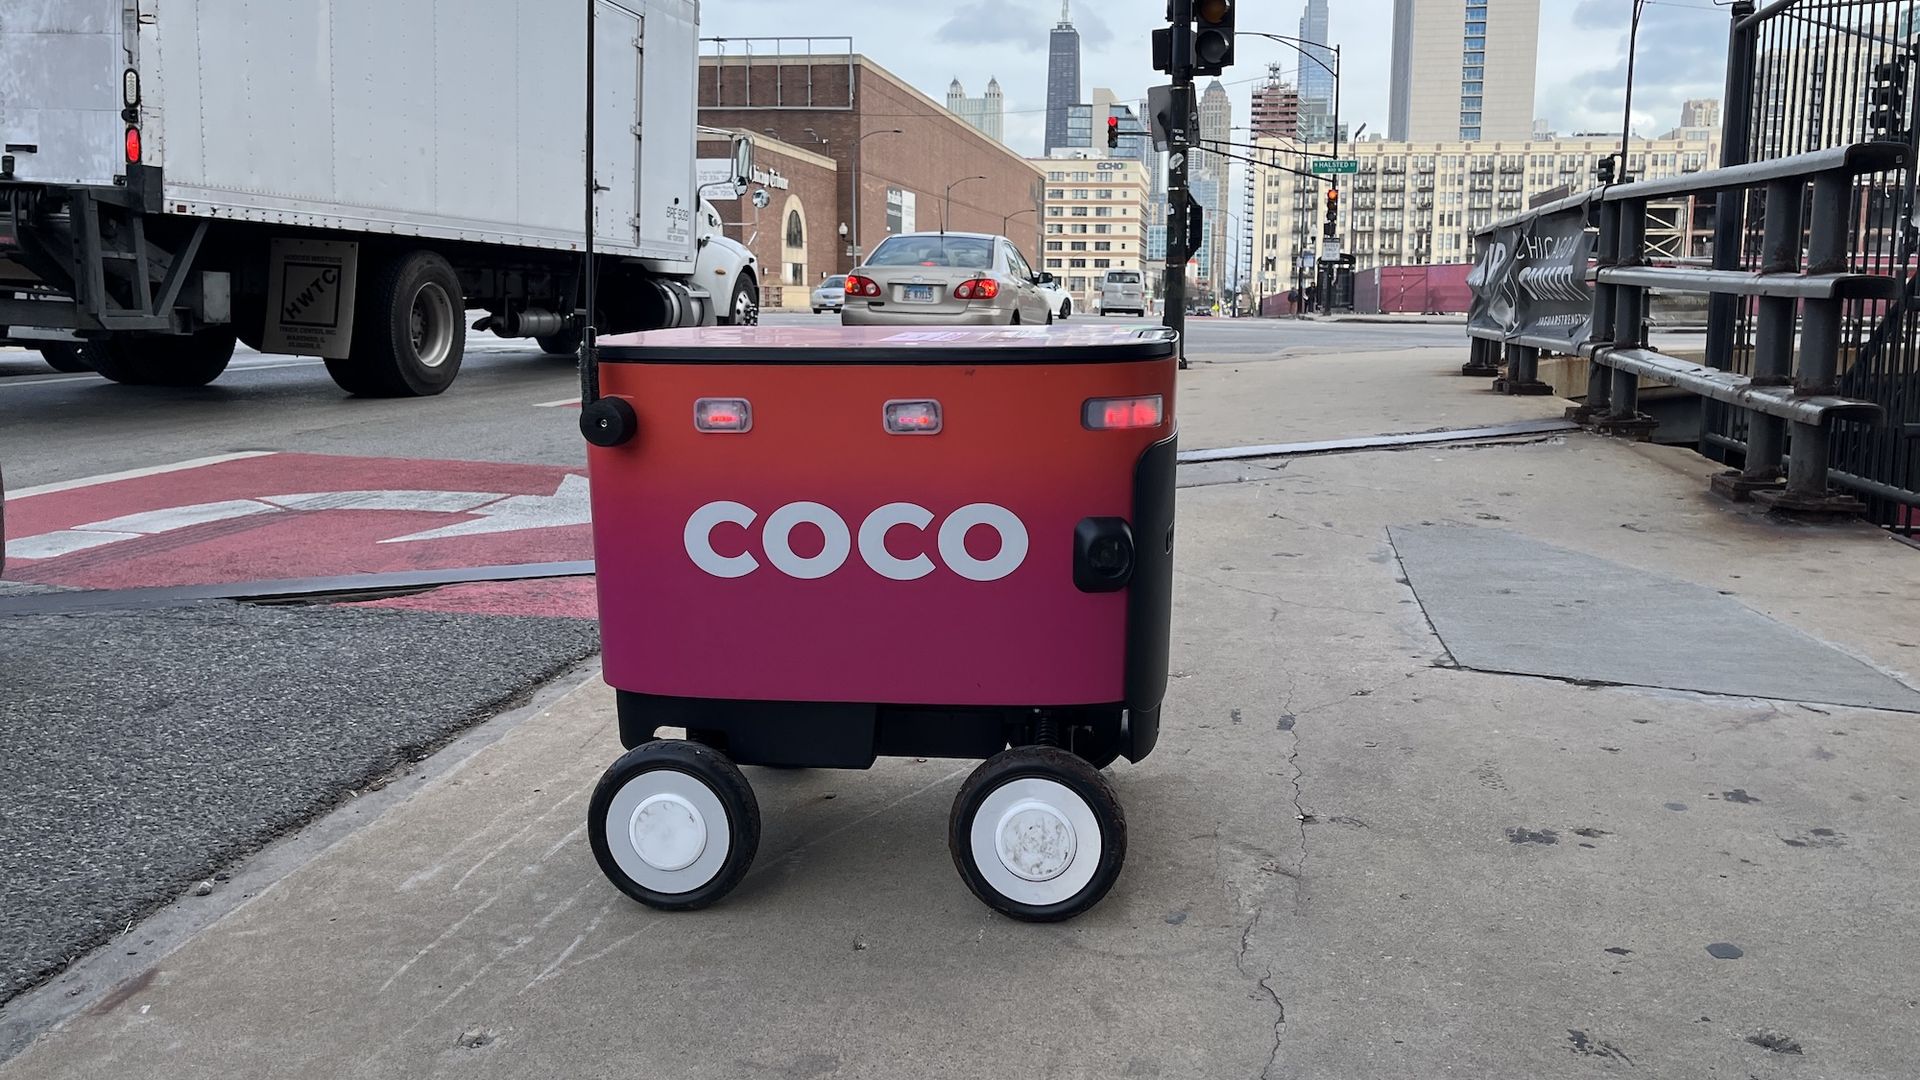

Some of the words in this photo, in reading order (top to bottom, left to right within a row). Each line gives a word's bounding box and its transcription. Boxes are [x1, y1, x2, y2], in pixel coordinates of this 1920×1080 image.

[1096, 162, 1123, 171] ECHO
[1319, 161, 1349, 169] HALSTED
[284, 269, 337, 319] HWTC
[684, 500, 1029, 581] COCO
